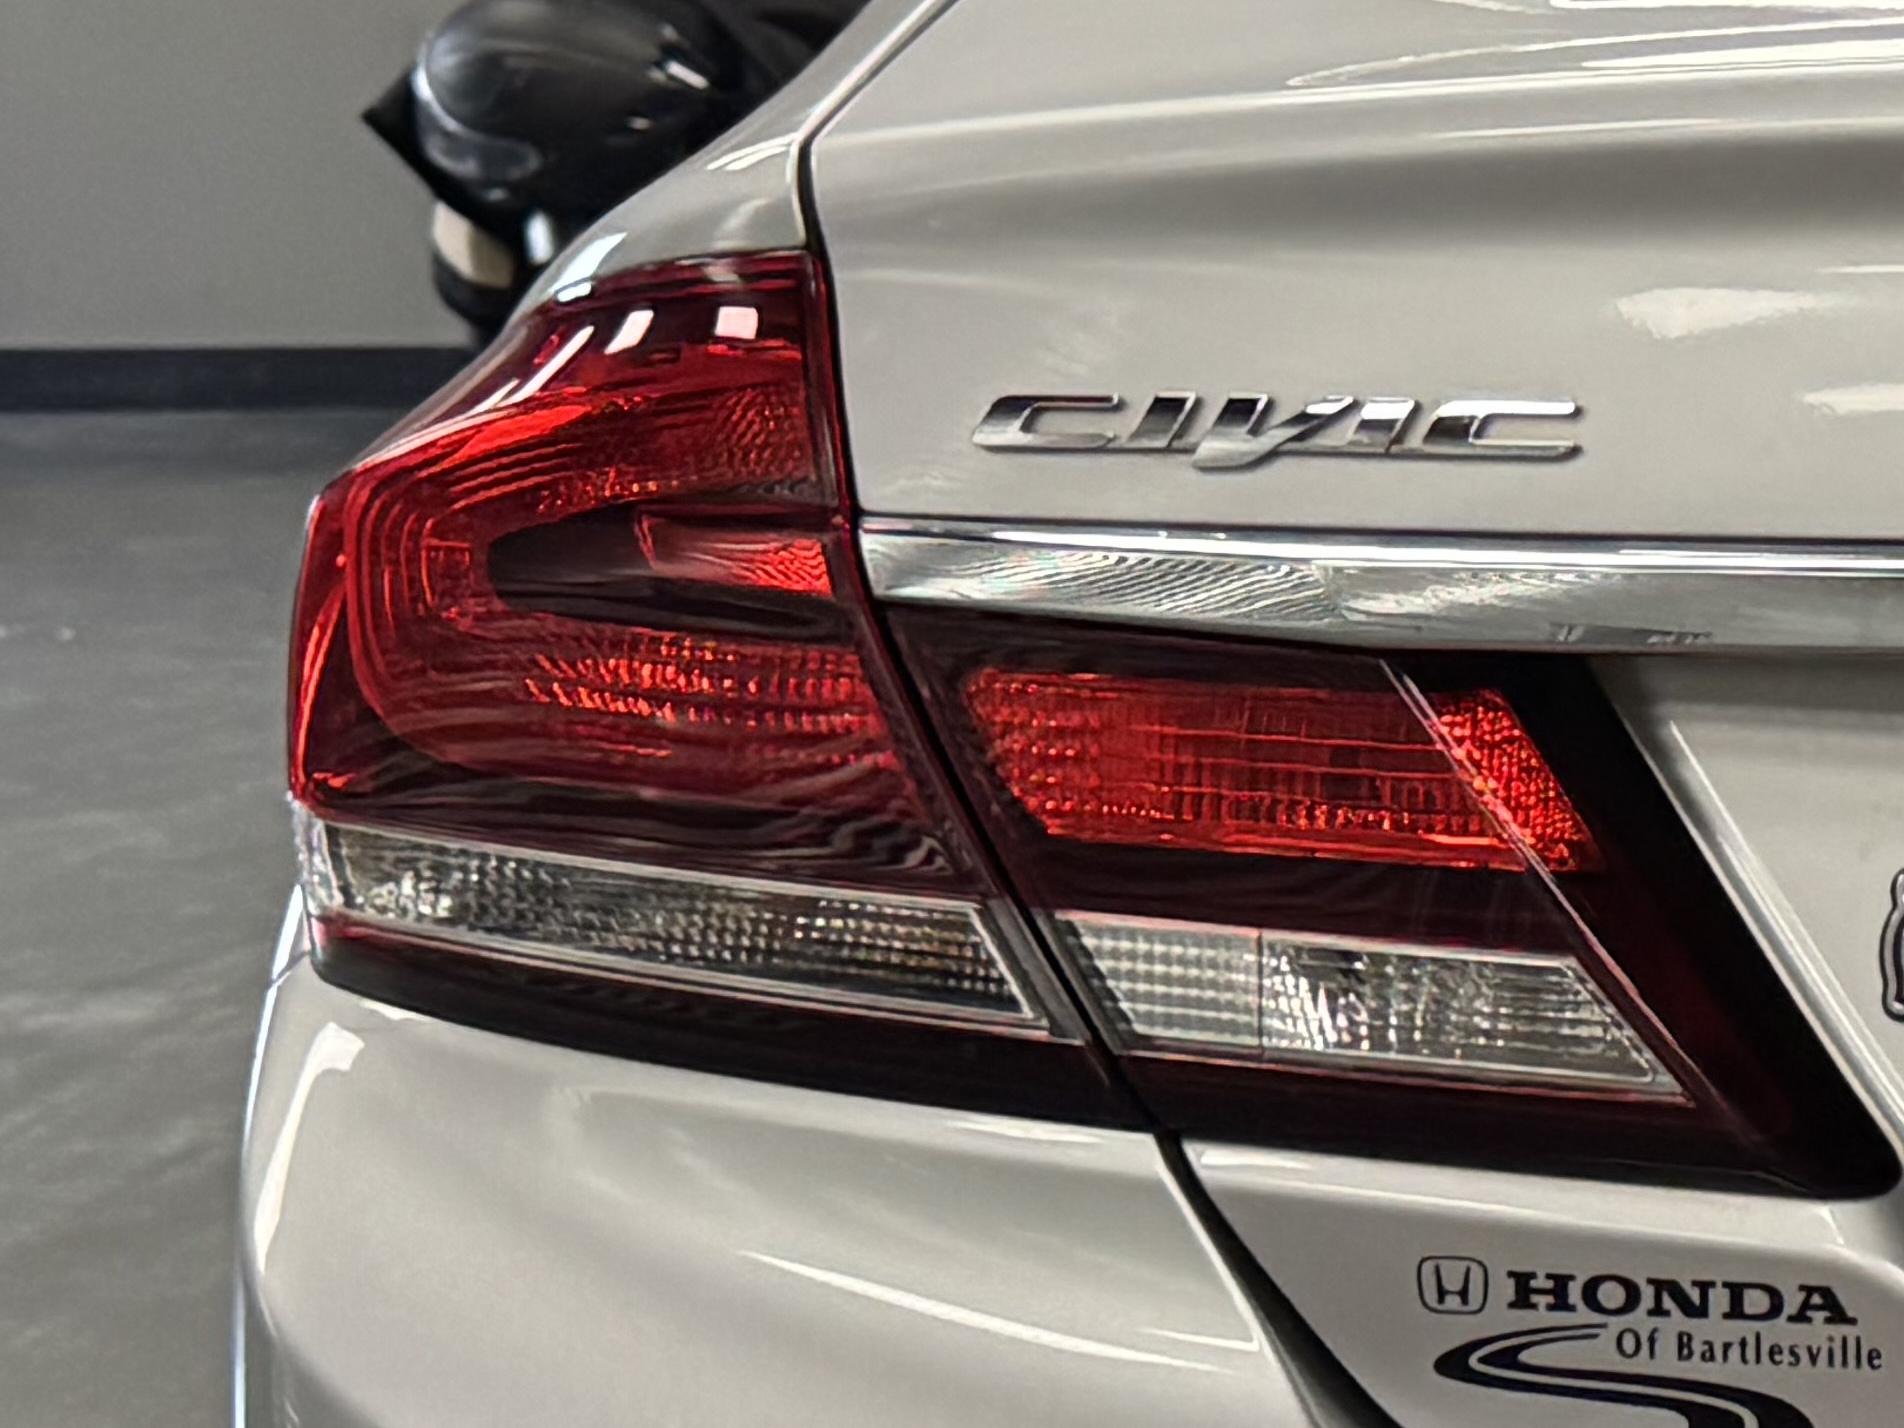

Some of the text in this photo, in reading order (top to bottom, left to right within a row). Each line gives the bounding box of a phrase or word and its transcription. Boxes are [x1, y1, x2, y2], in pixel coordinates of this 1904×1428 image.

[972, 389, 1586, 473] CIVIC
[1506, 1269, 1858, 1327] HONDA
[1615, 1327, 1884, 1371] Of Bartlesville
